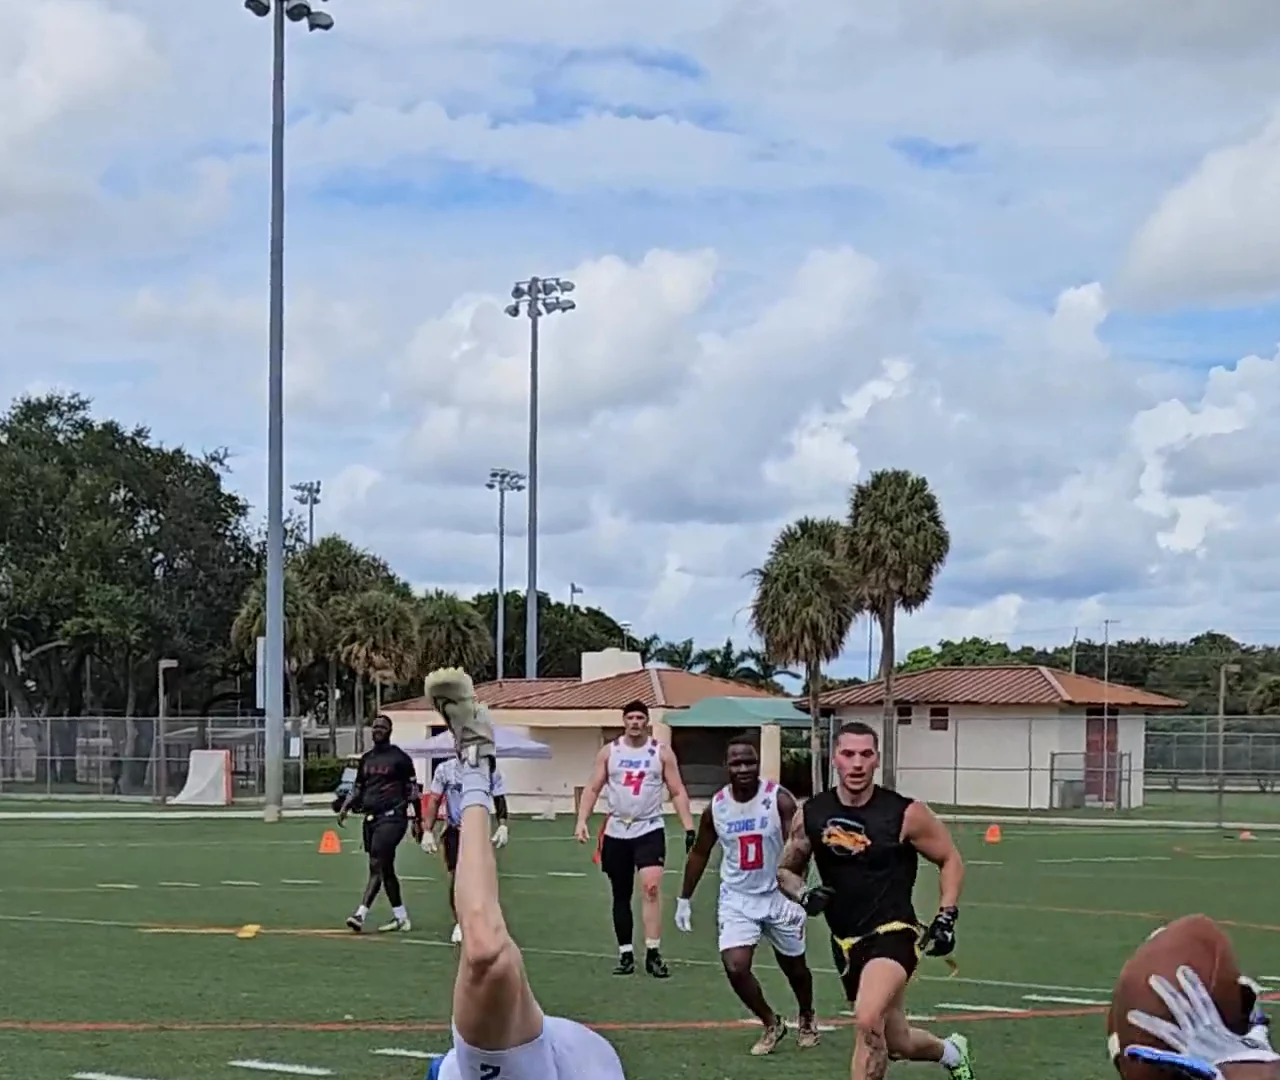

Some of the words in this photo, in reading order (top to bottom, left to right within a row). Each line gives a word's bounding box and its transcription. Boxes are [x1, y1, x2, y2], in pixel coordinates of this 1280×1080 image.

[622, 770, 646, 796] 4
[726, 818, 756, 834] ZONE
[739, 834, 764, 871] 0
